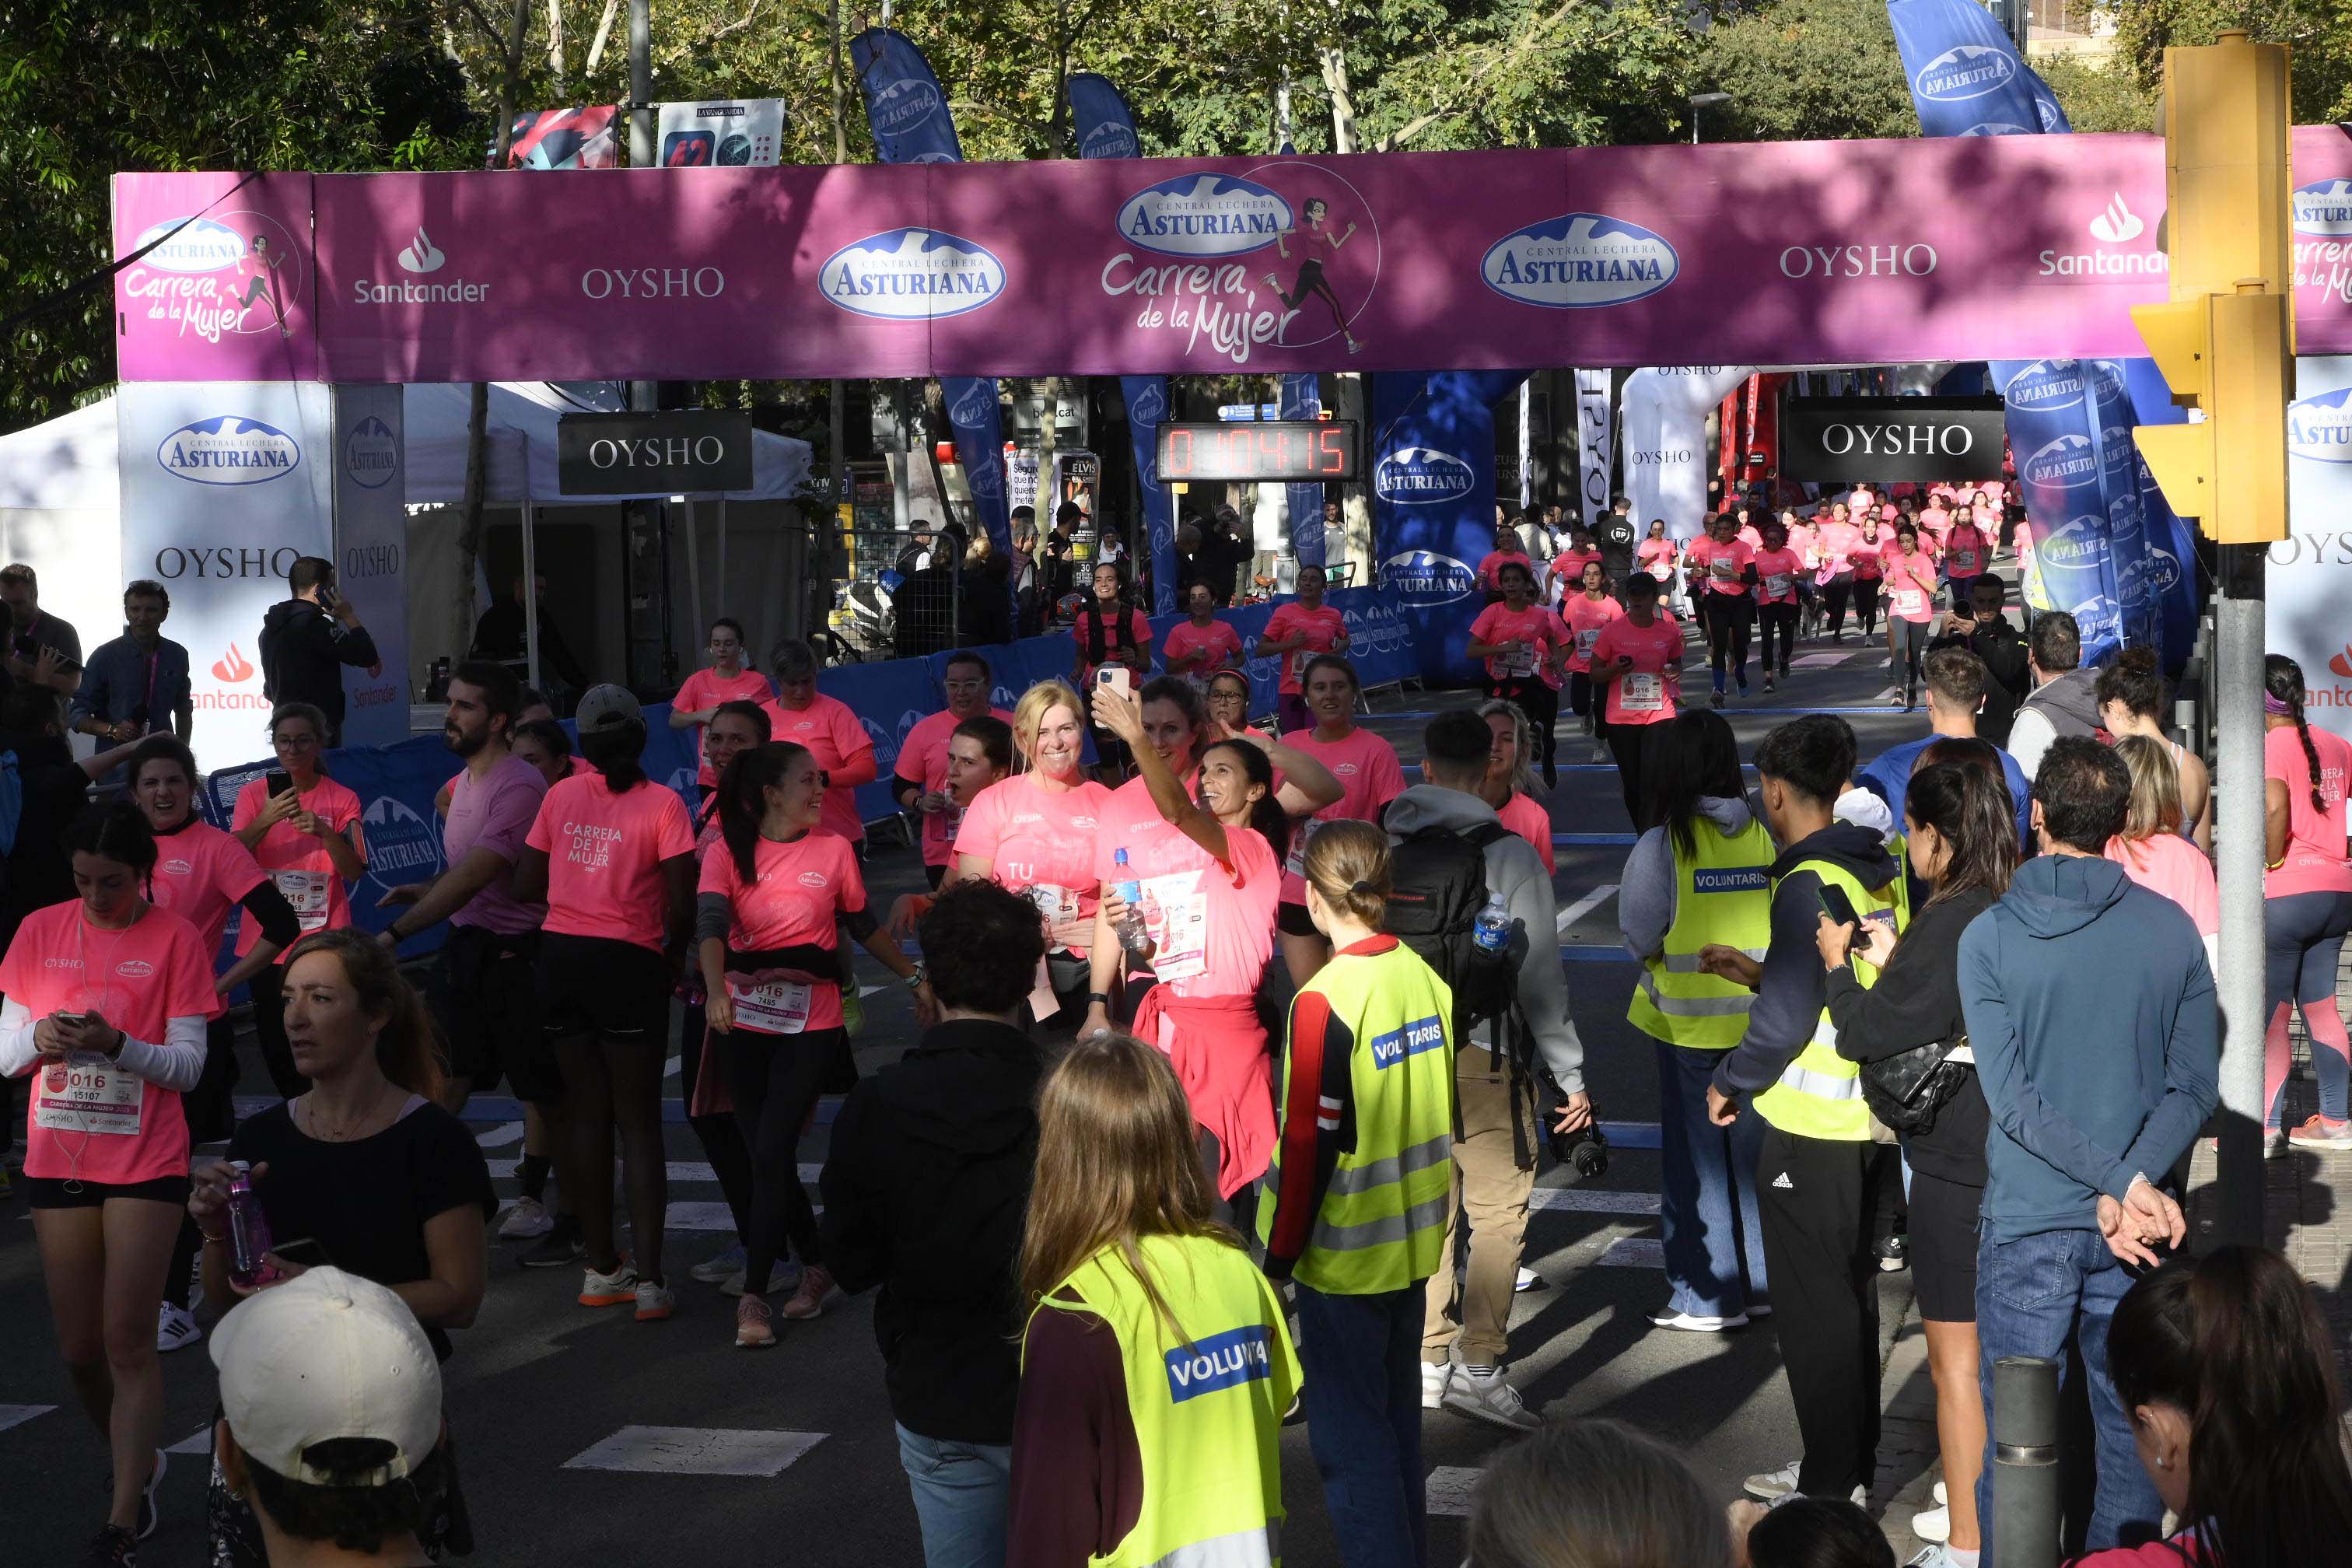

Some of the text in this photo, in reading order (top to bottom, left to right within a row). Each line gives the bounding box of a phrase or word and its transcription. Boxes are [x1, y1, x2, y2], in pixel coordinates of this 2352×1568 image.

[1157, 199, 1275, 211] CENTRAL LECHERA
[1130, 205, 1279, 236] ASTURIANA
[1526, 243, 1657, 257] CENTRAL LECHERA
[862, 258, 985, 268] CENTRAL LECHERA
[1496, 250, 1664, 284] ASTURIANA
[1780, 244, 1937, 277] OYSHO
[2039, 249, 2168, 276] Santand
[124, 268, 216, 299] Carrera
[582, 266, 726, 299] OYSHO
[832, 261, 992, 296] ASTURIANA
[1101, 252, 1246, 296] Carrera
[355, 278, 490, 303] Santander
[148, 289, 253, 343] de la Mujer
[1136, 290, 1301, 363] de la Mujer
[190, 438, 285, 448] CENTRAL LECHERA
[1822, 424, 1973, 455] OYSHO
[168, 441, 290, 467] ASTURIANA
[589, 436, 724, 468] OYSHO
[1632, 450, 1692, 466] OYSHO
[1072, 463, 1096, 474] ELVIS
[1378, 472, 1467, 492] ASTURIANA
[347, 544, 399, 579] OYSHO
[1080, 564, 1090, 572] 30
[2326, 779, 2338, 791] LA
[563, 821, 623, 843] CARRERA
[366, 836, 437, 873] ASTURIANA
[572, 836, 608, 854] DE LA
[568, 849, 609, 867] MUJER
[1008, 863, 1034, 880] TU
[1696, 872, 1768, 889] VOLUNTARIS
[44, 958, 85, 970] OYSHO
[758, 997, 776, 1006] 7485
[1374, 1024, 1442, 1061] VOLTARIS
[71, 1073, 107, 1088] 016
[50, 1101, 75, 1110] CARRERA
[73, 1091, 100, 1101] 15107
[98, 1117, 132, 1127] Santander
